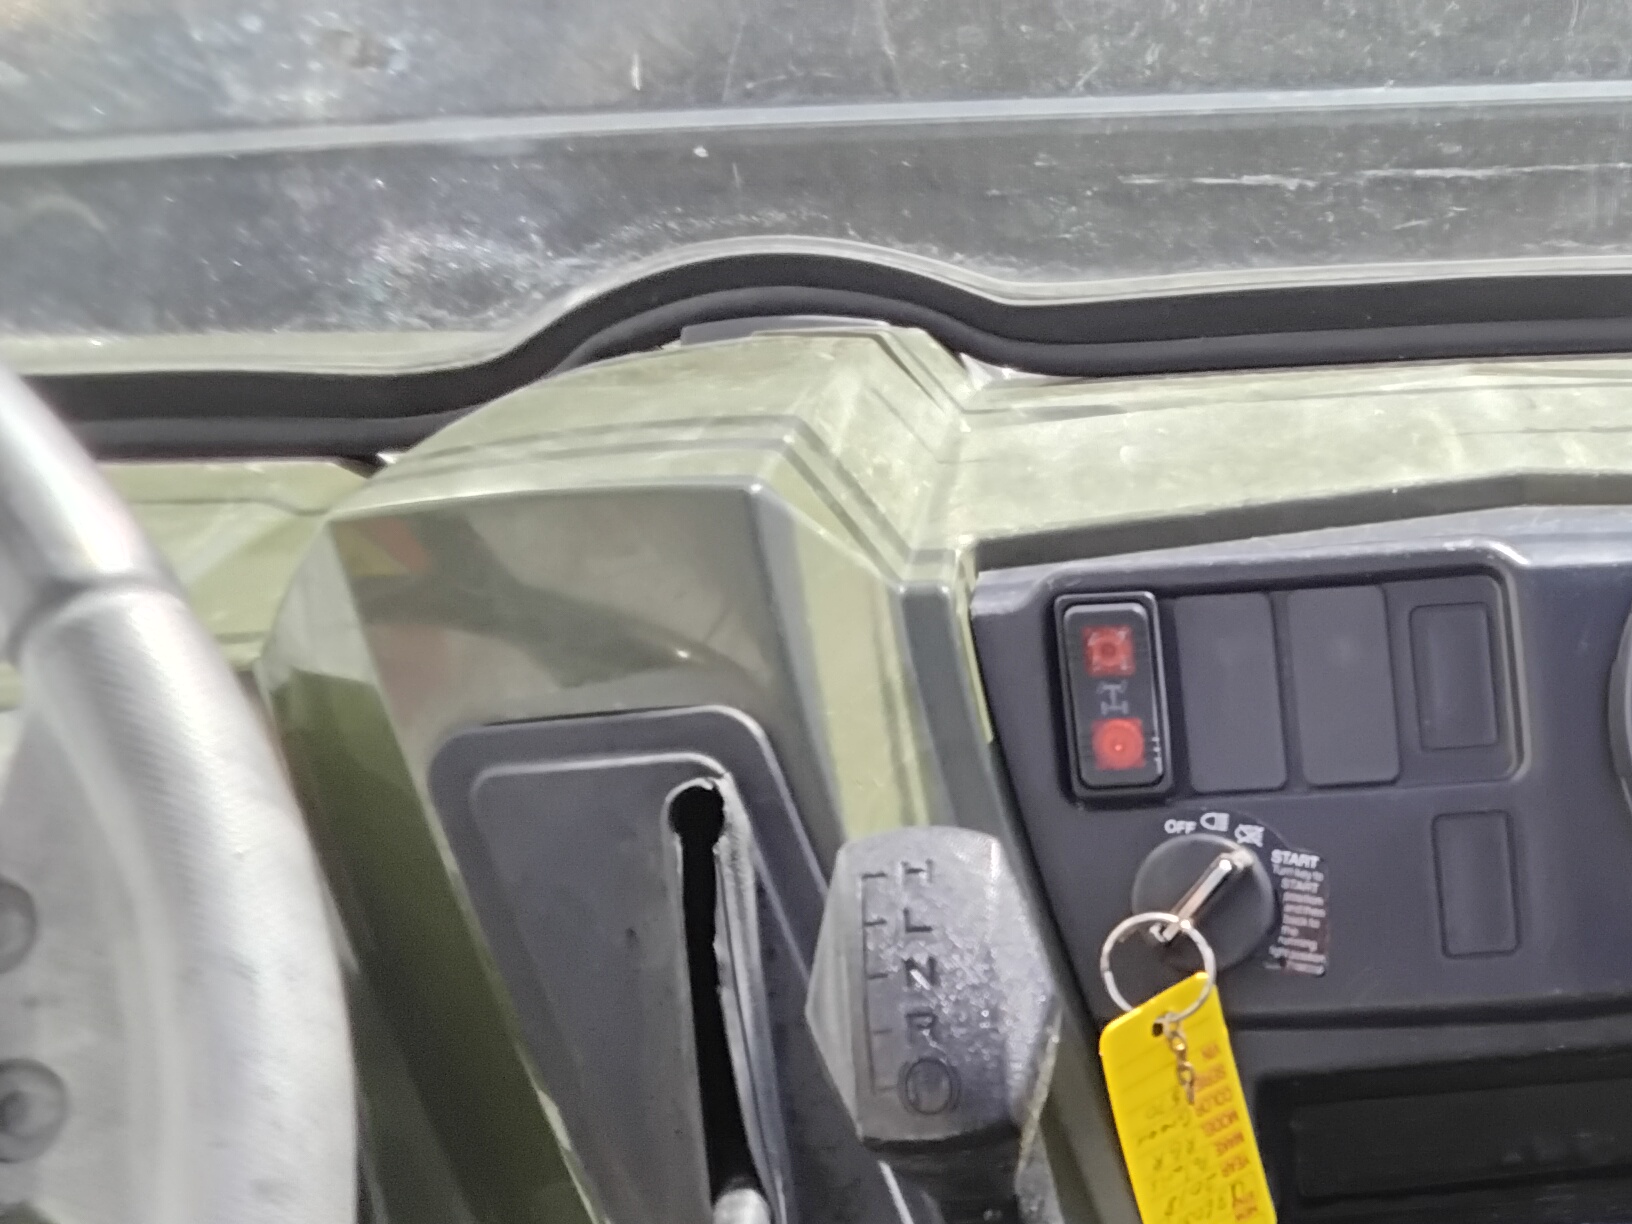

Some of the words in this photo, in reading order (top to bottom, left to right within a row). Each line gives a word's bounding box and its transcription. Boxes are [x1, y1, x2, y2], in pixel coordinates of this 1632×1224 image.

[1164, 818, 1196, 836] OFF
[901, 858, 934, 884] H
[1271, 849, 1320, 869] START
[903, 907, 933, 933] L
[904, 956, 938, 989] N
